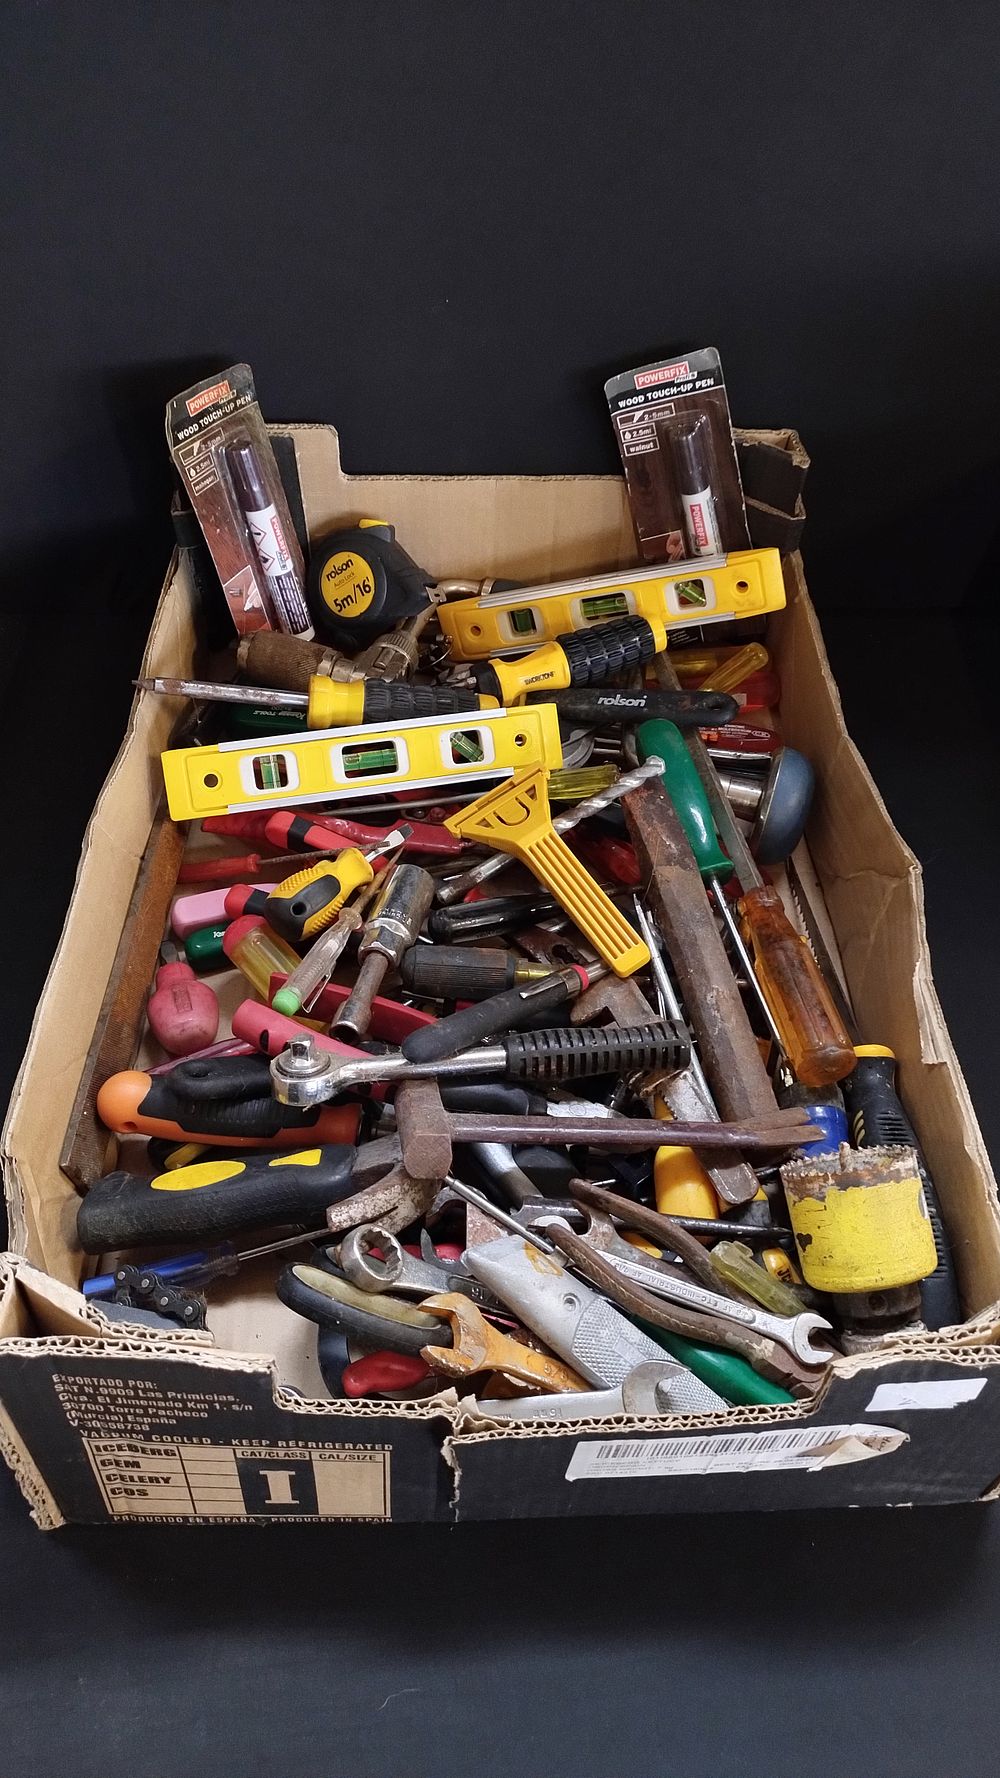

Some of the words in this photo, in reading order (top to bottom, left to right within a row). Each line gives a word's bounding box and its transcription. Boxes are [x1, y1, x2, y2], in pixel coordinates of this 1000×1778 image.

[637, 365, 686, 386] POWERFIX
[189, 384, 228, 412] POWERFIX
[618, 395, 645, 408] WOOD
[646, 382, 694, 401] TOUCH-UP
[695, 378, 714, 389] PEN
[177, 423, 199, 440] WOOD
[199, 402, 235, 427] TOUCH-UP
[236, 393, 252, 407] PEN
[629, 441, 654, 453] walnut
[691, 505, 708, 546] POWERFIX
[272, 517, 291, 560] POWERFIX
[325, 558, 354, 582] rolson
[597, 694, 646, 707] rolson
[52, 1373, 123, 1387] EXPORTADO
[128, 1380, 158, 1389] POR:
[54, 1383, 79, 1393] SAT
[138, 1389, 163, 1398] Las
[62, 1402, 105, 1412] 30700
[107, 1405, 144, 1414] Torre
[148, 1407, 208, 1418] Pacheco
[97, 1395, 111, 1403] El
[115, 1396, 183, 1408] Jimenado
[186, 1401, 209, 1409] Km
[231, 1403, 253, 1411] s/n
[66, 1410, 124, 1422] (Murcia)
[127, 1414, 177, 1425] España
[93, 1443, 177, 1457] ICEBERG
[152, 1434, 211, 1445] COOLED
[231, 1438, 270, 1447] KEEP
[277, 1440, 393, 1450] REFRIGERATED
[241, 1450, 307, 1459] CAT/CLASS
[318, 1453, 377, 1461] CAL/SIZE
[100, 1458, 142, 1469] GEM
[105, 1473, 172, 1484] CELERY
[110, 1487, 149, 1497] COS
[259, 1470, 300, 1504] I
[113, 1515, 183, 1523] PRODUCIDO
